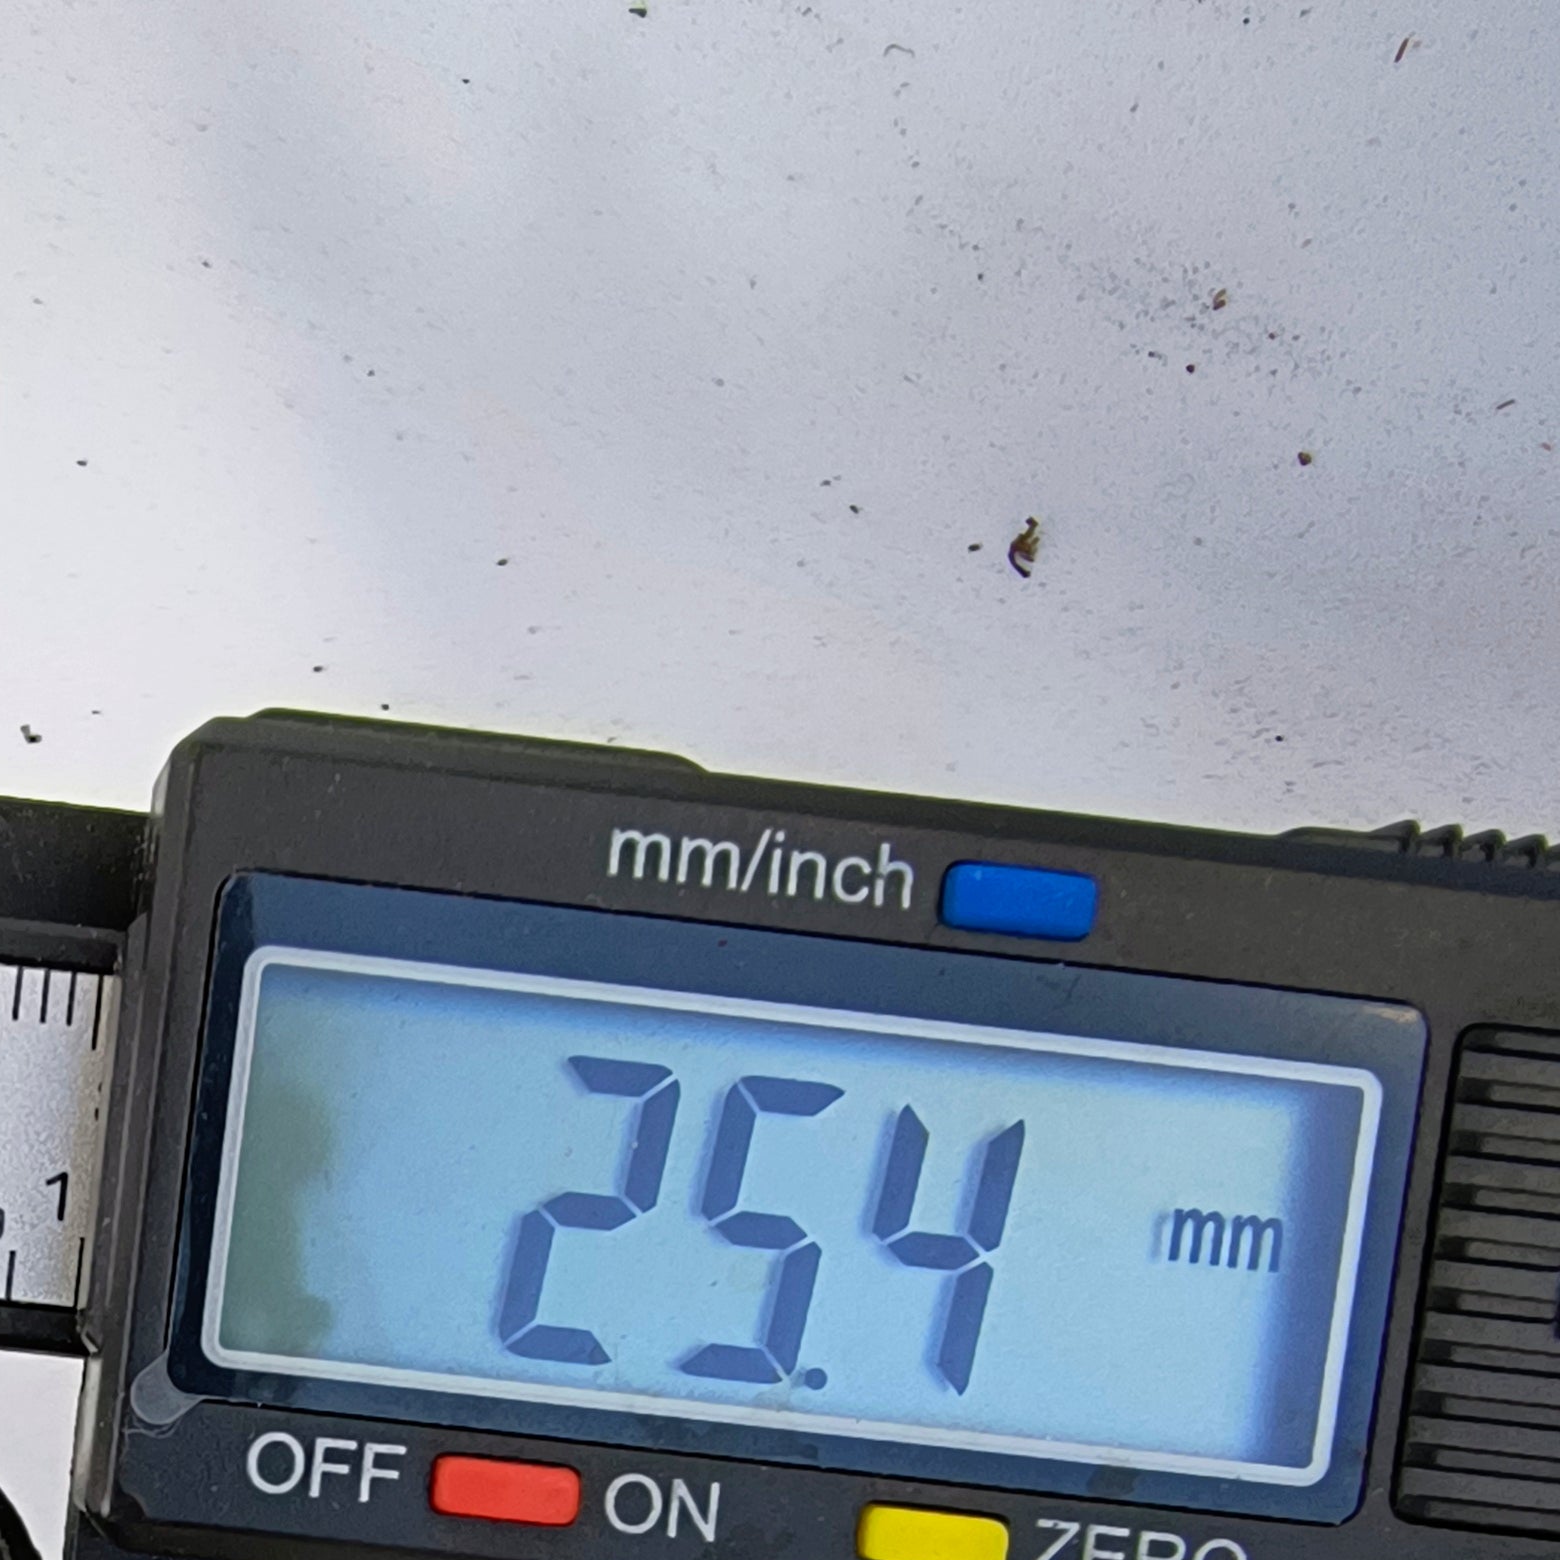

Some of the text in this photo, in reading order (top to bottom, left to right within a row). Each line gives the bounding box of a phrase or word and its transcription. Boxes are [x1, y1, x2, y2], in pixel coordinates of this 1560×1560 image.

[607, 824, 915, 912] mm/inch
[44, 1171, 71, 1222] 1
[498, 1052, 1283, 1398] 25.4 mm
[246, 1430, 723, 1544] OFF ON
